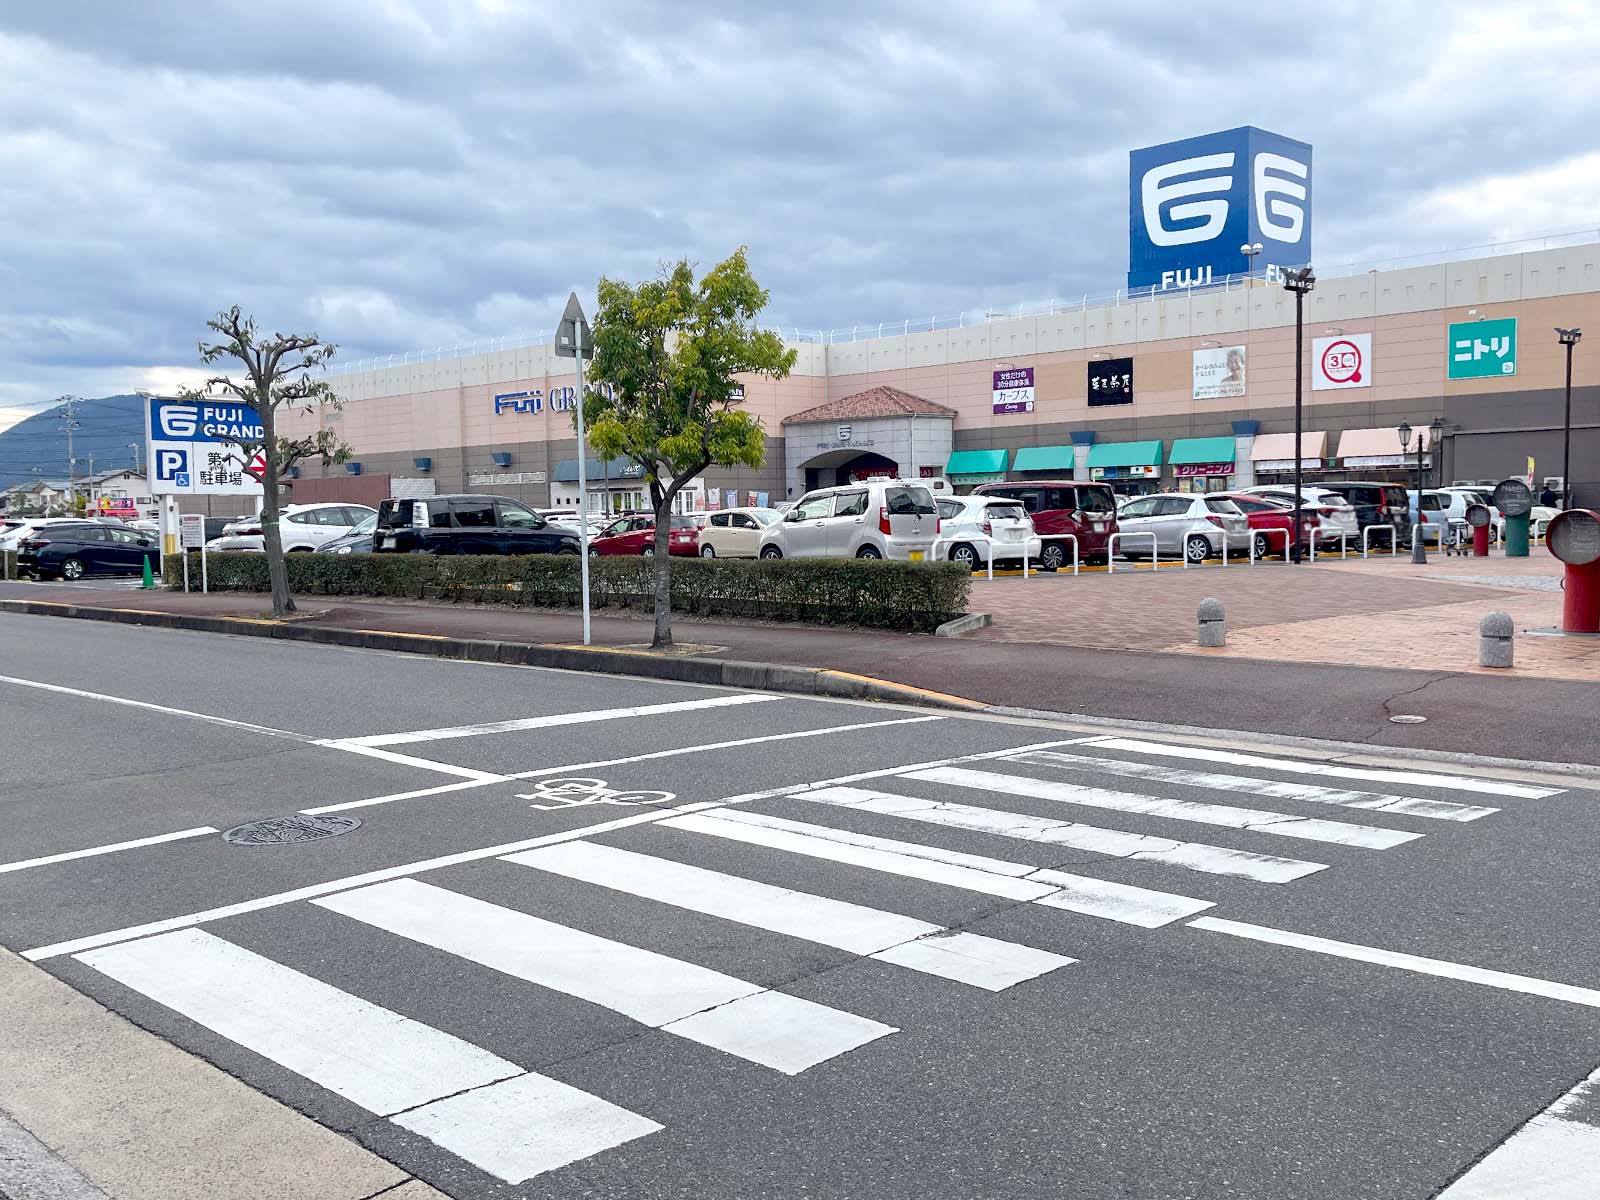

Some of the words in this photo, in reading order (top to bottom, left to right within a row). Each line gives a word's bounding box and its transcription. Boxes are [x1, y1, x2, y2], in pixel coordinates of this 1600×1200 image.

[1161, 265, 1212, 290] FUJI
[1454, 336, 1510, 362] ニトリ
[203, 407, 243, 422] FUJI
[203, 423, 265, 438] GRAND
[1181, 464, 1233, 475] クリーニング
[199, 471, 243, 486] 駐車場
